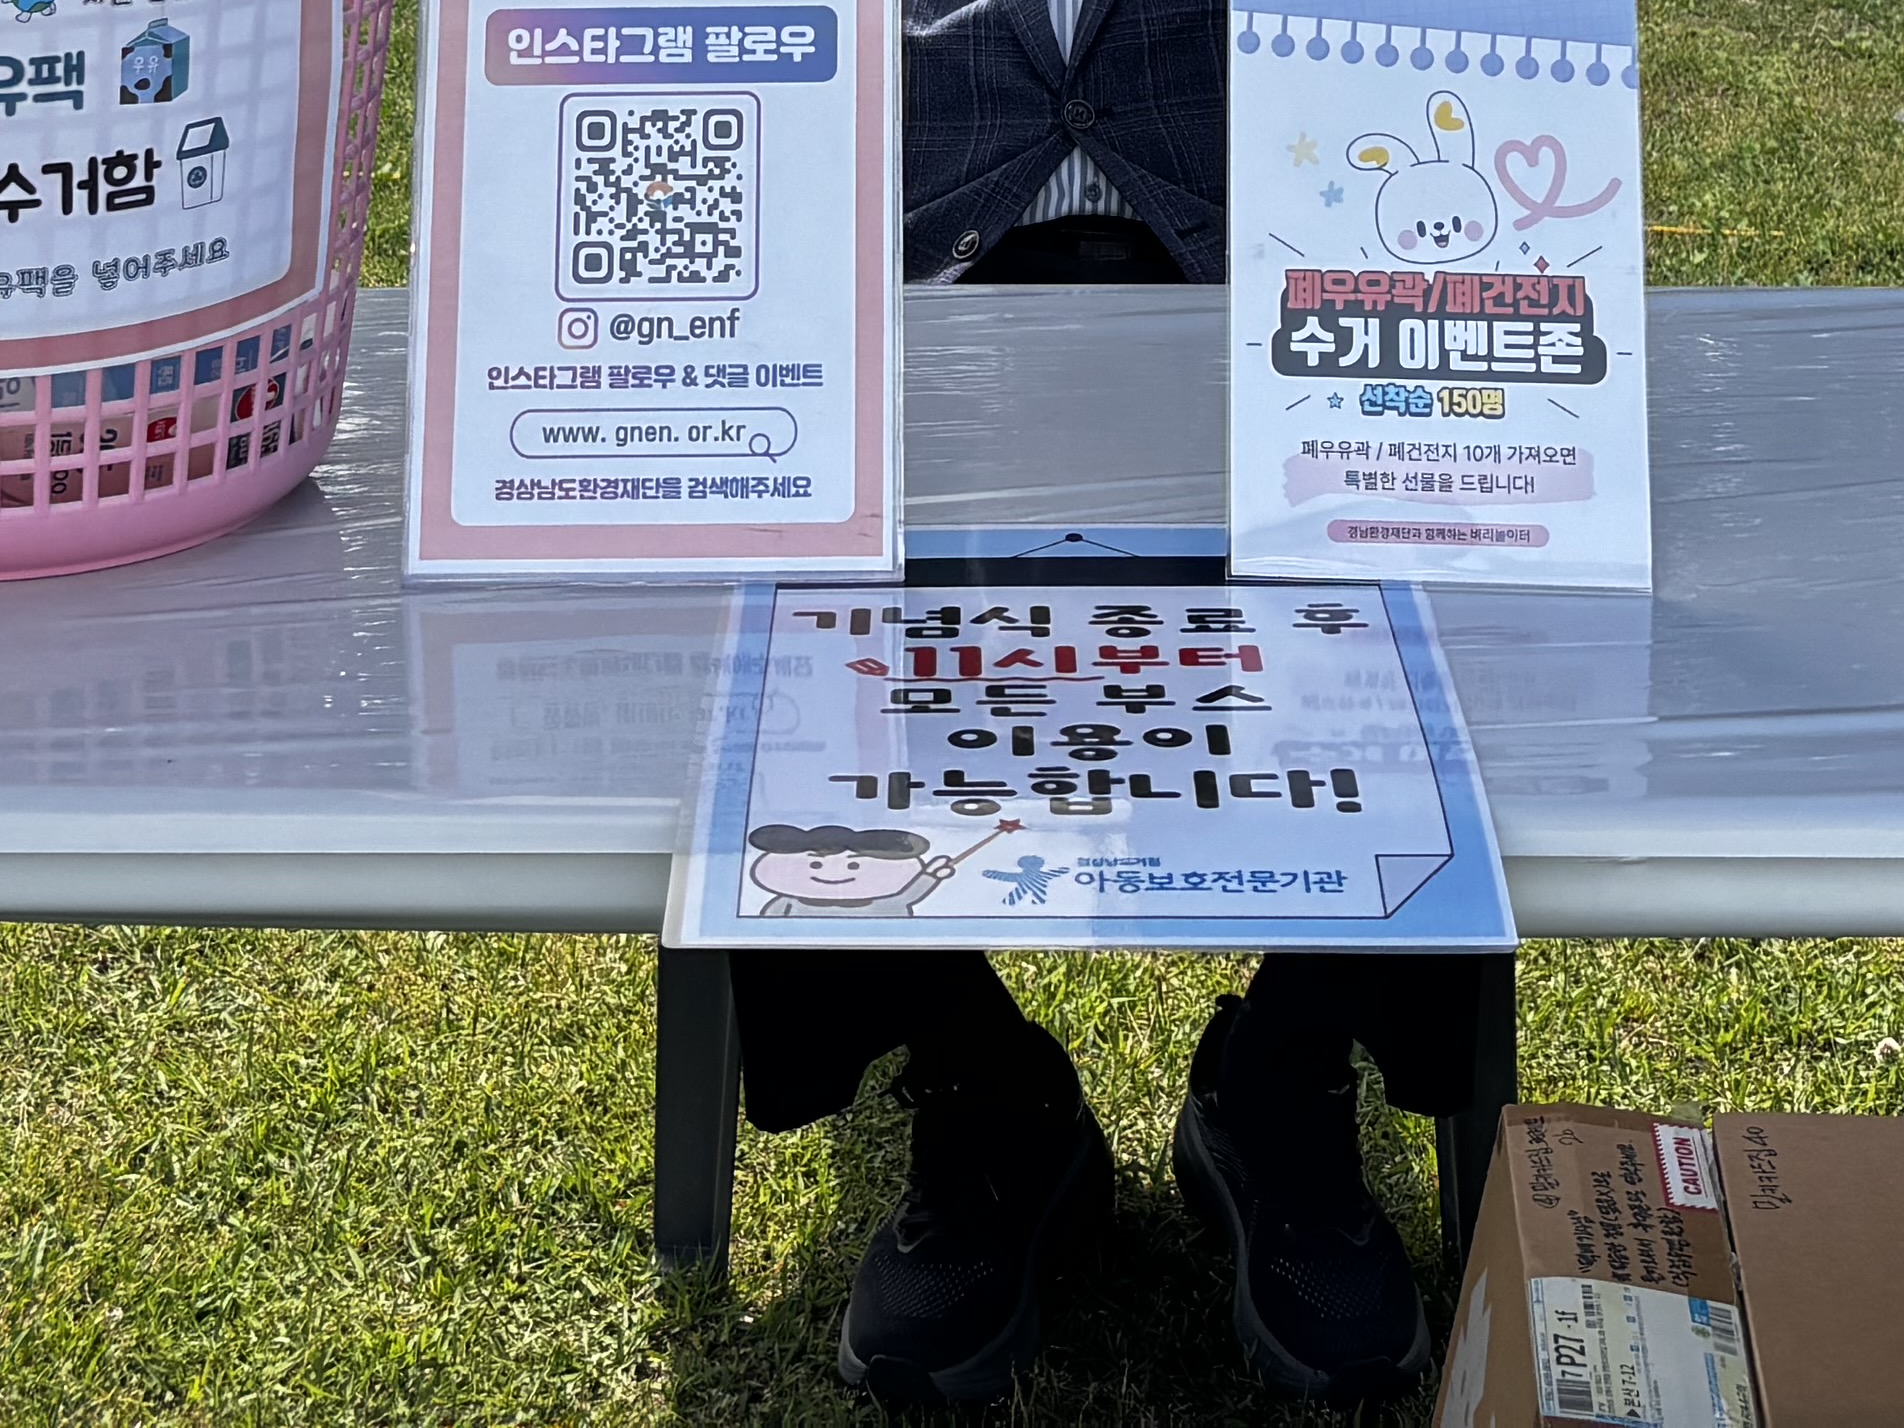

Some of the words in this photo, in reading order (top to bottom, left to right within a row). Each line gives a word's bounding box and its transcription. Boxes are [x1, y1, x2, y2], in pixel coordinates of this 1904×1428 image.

[507, 25, 693, 65] 인스타그램
[705, 25, 816, 63] 팔로우
[133, 56, 159, 74] 우유
[91, 236, 230, 291] 넣어주세요
[1285, 269, 1586, 316] 폐우유곽/폐건전지
[609, 307, 741, 345] @gn_enf
[1289, 316, 1381, 369] 수거
[1398, 318, 1585, 374] 이벤트존
[487, 365, 602, 391] 인스타그램
[608, 363, 676, 389] 팔로우
[682, 364, 699, 387] &
[704, 363, 749, 388] 댓글
[756, 362, 824, 388] 이벤트
[1360, 383, 1433, 417] 선착순
[1437, 387, 1505, 419] 150명
[542, 425, 607, 444] www.
[687, 419, 747, 442] or.kr
[1375, 442, 1383, 461] /
[1462, 445, 1502, 464] 10개
[1507, 446, 1577, 466] 가져오면
[495, 477, 682, 501] 경상남도환경재단을
[687, 476, 812, 500] 검색해주세요
[1344, 471, 1397, 492] 특별한
[1402, 473, 1454, 493] 선물을
[1459, 475, 1535, 494] 드립니다!
[792, 602, 1053, 640] 기념식
[1089, 604, 1255, 638] 종료
[1293, 602, 1369, 635] 후
[904, 644, 1266, 679] 11시부터
[880, 682, 1057, 718] 모든
[1096, 683, 1273, 713] 부스
[946, 722, 1233, 761] 이용이
[828, 766, 1365, 817] 가능합니다!
[1074, 869, 1348, 894] 아동보호전문기관
[1677, 1137, 1702, 1197] CAUTION
